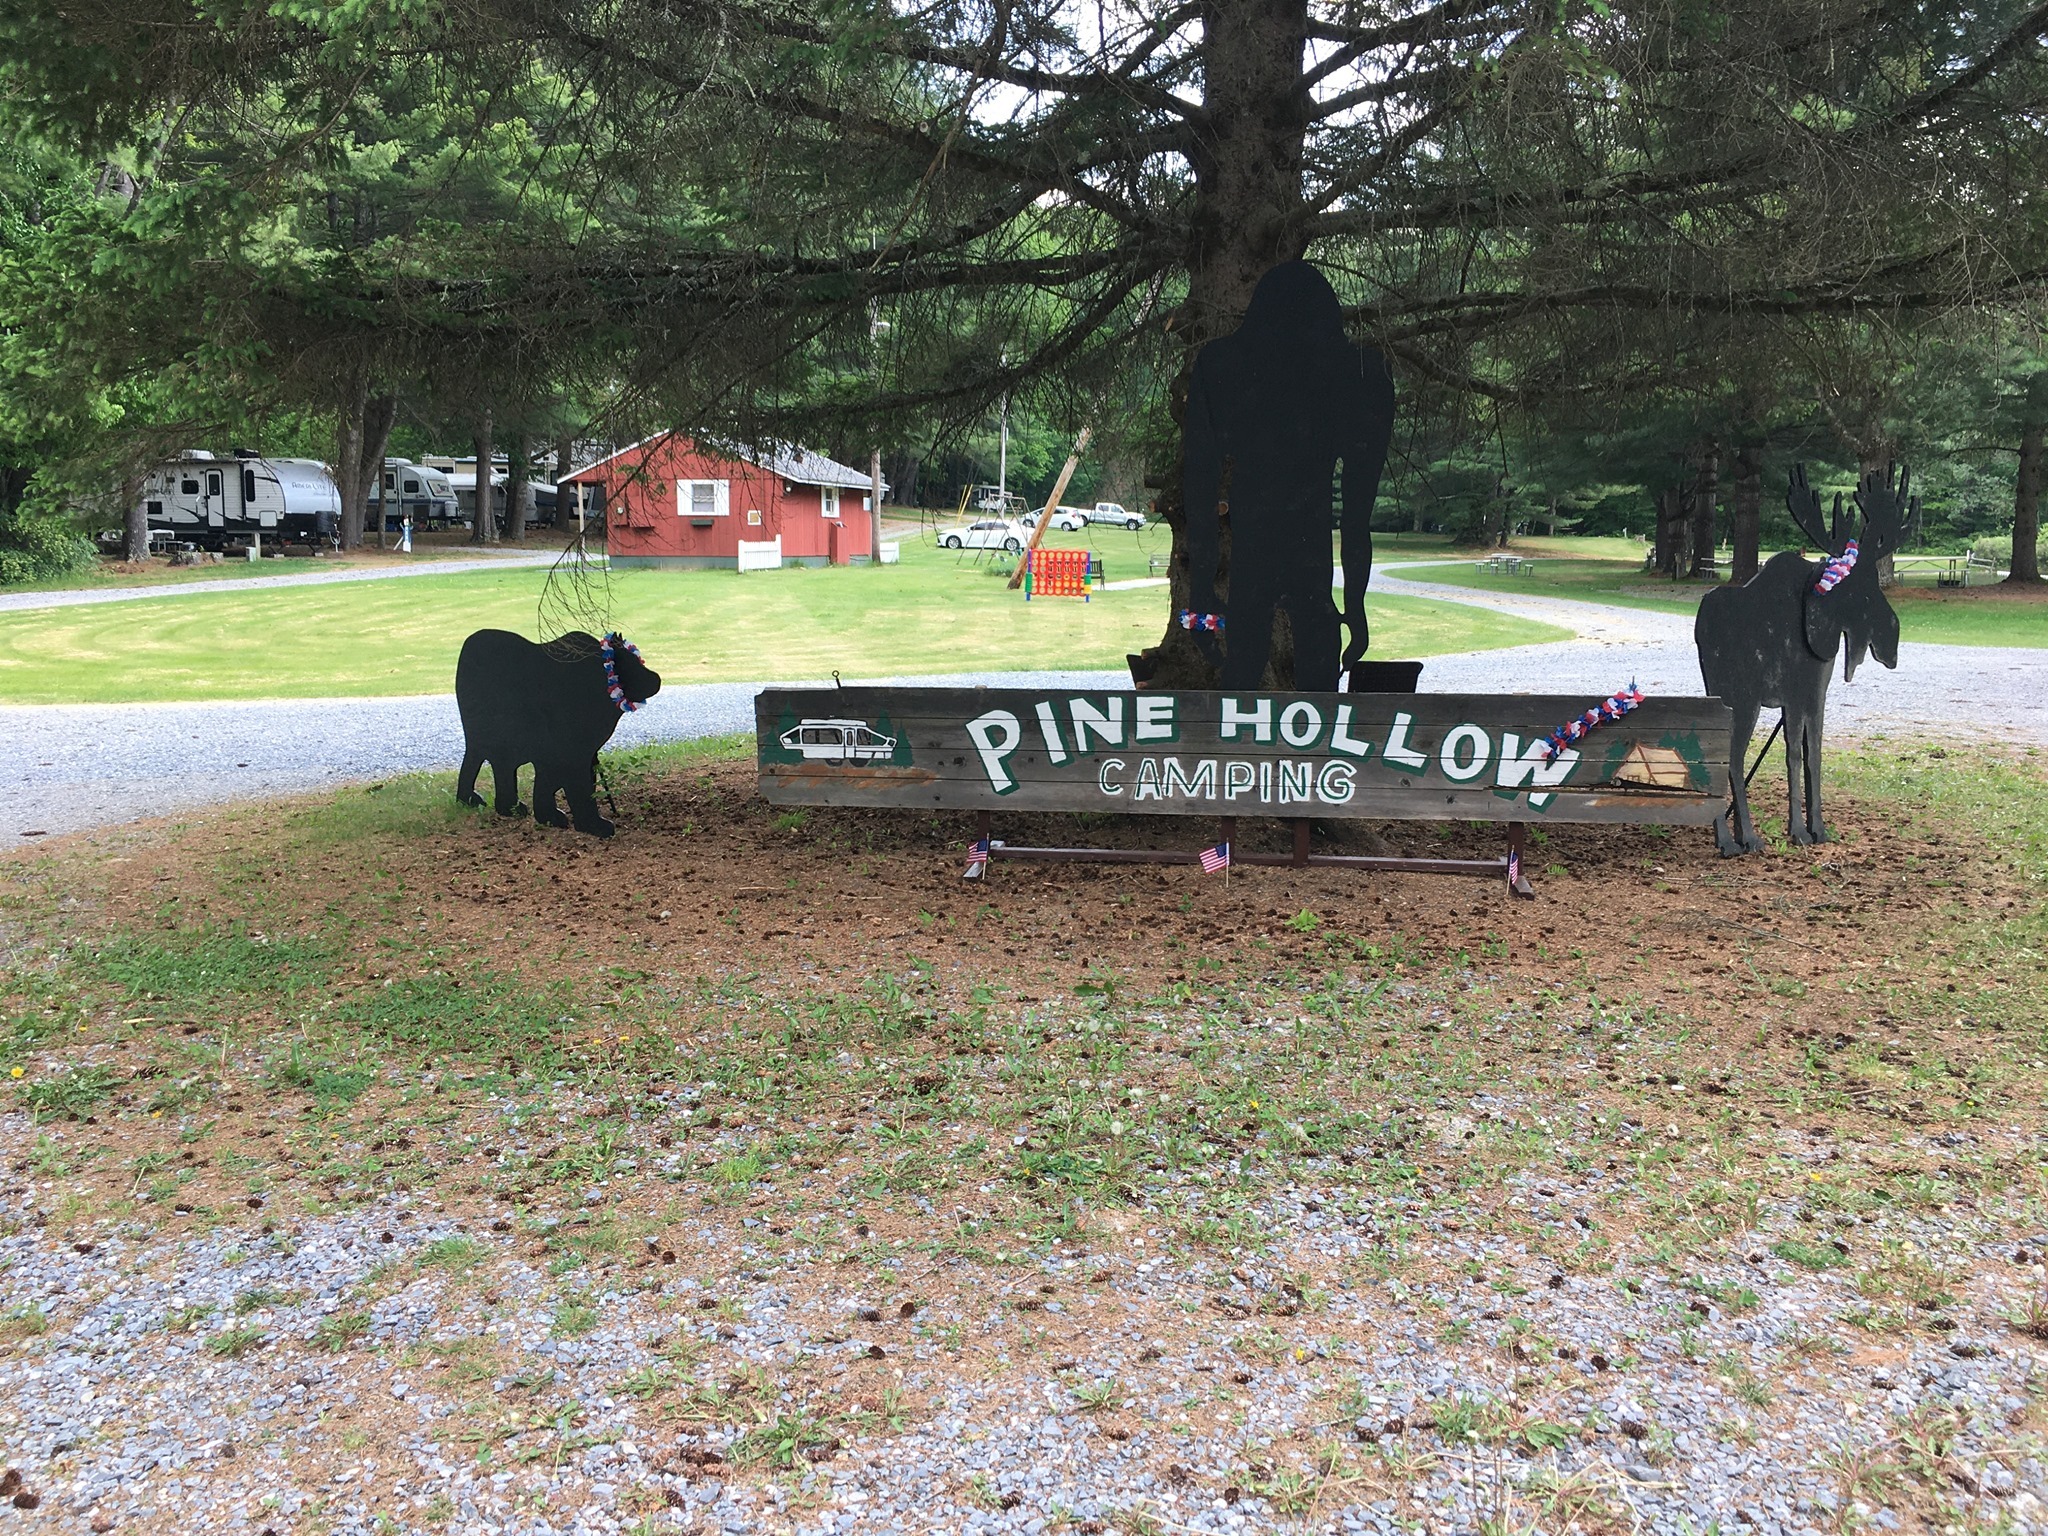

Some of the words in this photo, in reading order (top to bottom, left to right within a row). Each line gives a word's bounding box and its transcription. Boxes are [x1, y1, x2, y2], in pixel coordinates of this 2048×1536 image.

[965, 696, 1179, 795] PINE
[1220, 698, 1582, 813] HOLLOW
[1100, 757, 1356, 804] CAMPING
